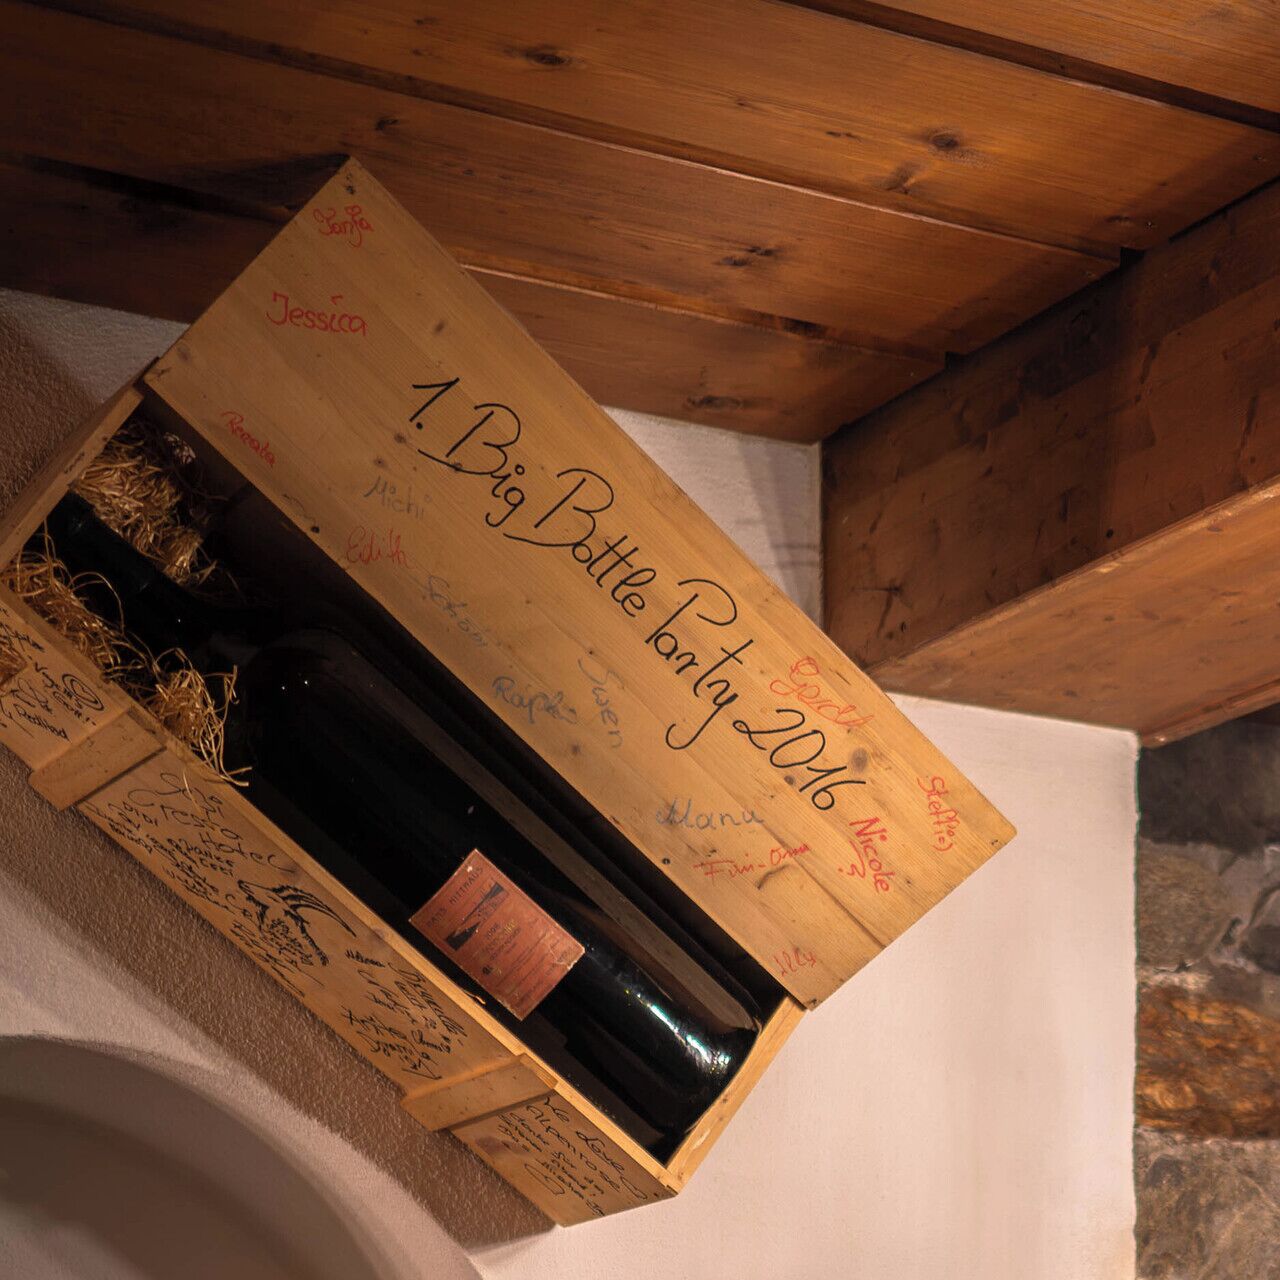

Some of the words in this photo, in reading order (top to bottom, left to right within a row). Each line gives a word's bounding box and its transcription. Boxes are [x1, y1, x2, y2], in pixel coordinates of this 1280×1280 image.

[265, 291, 368, 337] Jessica
[409, 376, 460, 430] 1.
[418, 403, 525, 527] Big
[503, 468, 657, 617] Bottle
[645, 578, 753, 750] Party
[732, 708, 866, 811] 2016
[849, 815, 896, 894] Nicole
